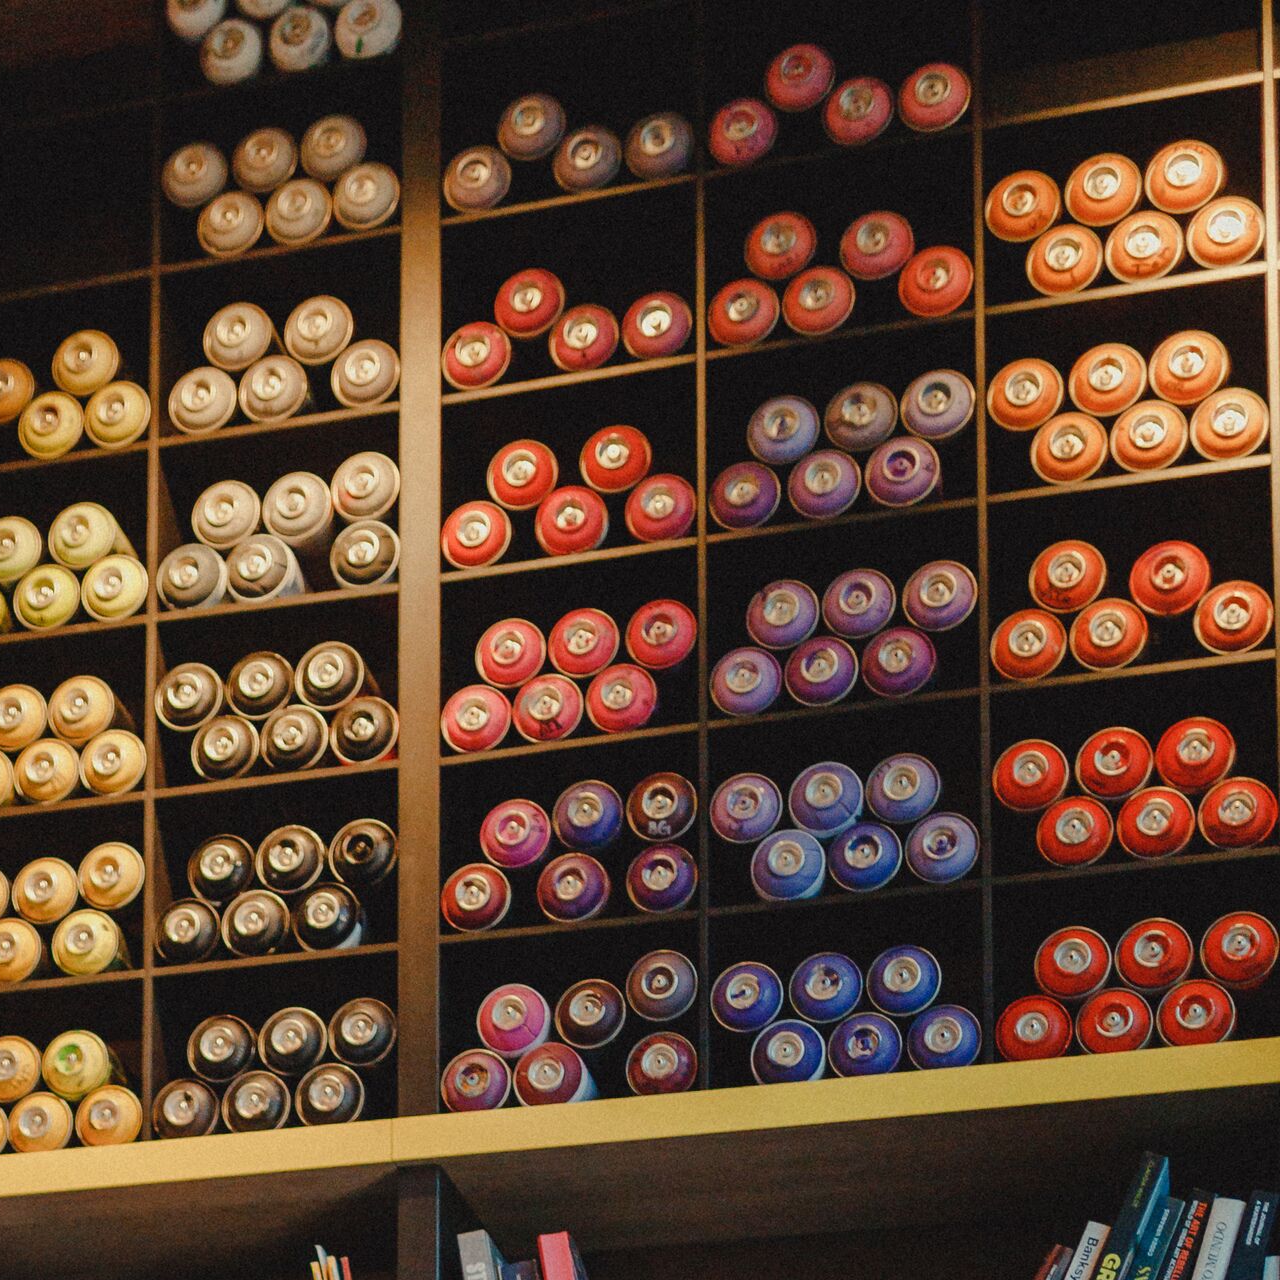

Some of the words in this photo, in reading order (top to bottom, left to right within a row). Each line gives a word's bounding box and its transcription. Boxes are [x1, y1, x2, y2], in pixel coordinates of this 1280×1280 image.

[1194, 1201, 1207, 1218] THE
[1187, 1218, 1201, 1235] ART
[1183, 1236, 1194, 1249] OF
[1205, 1221, 1228, 1267] MUNDO
